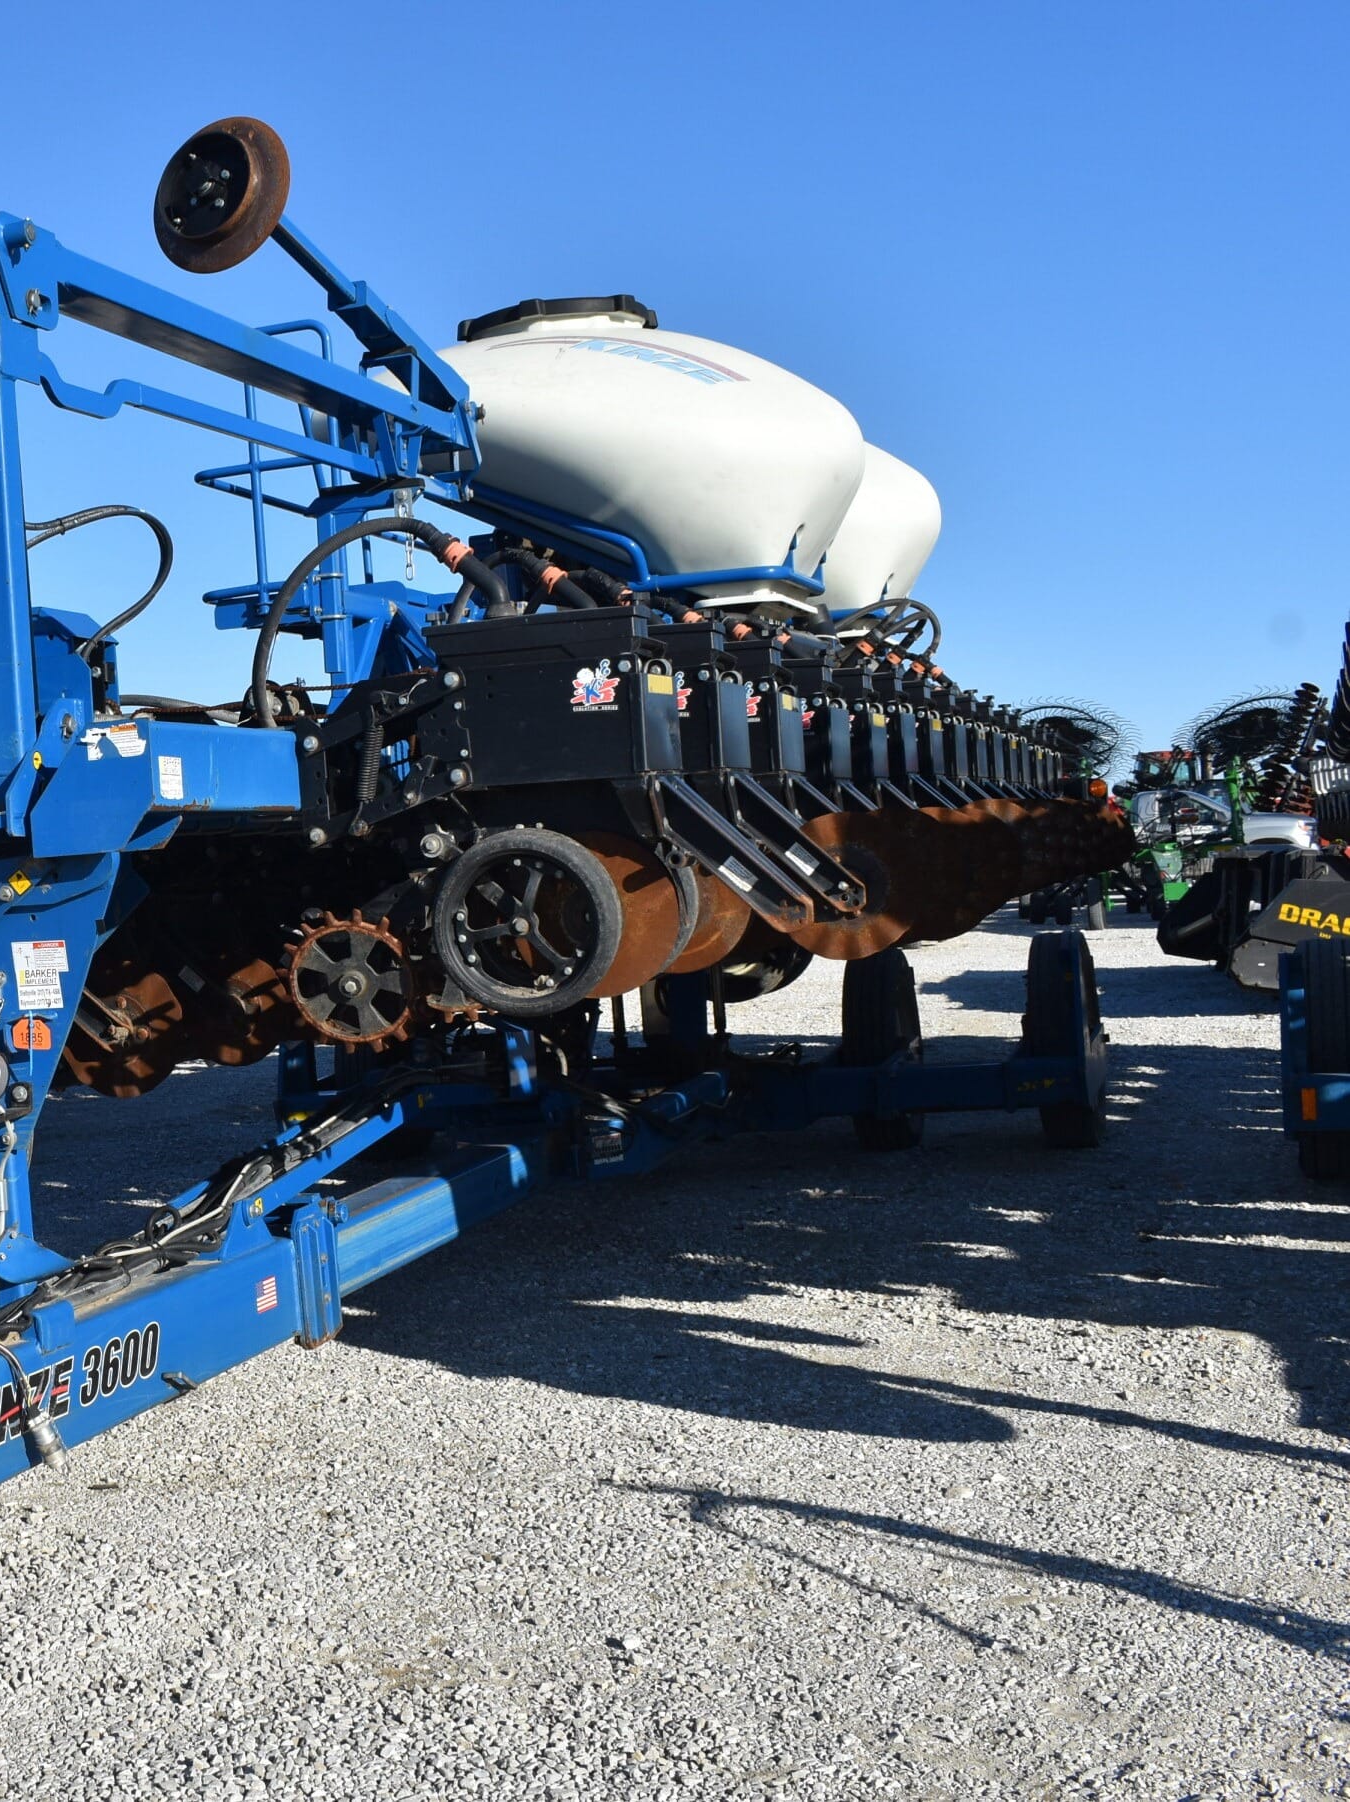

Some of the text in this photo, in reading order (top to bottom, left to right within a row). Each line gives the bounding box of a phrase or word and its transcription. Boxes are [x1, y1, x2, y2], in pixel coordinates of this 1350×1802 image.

[570, 339, 734, 384] KINZE
[25, 969, 57, 979] BARKER
[79, 1321, 160, 1407] 3600
